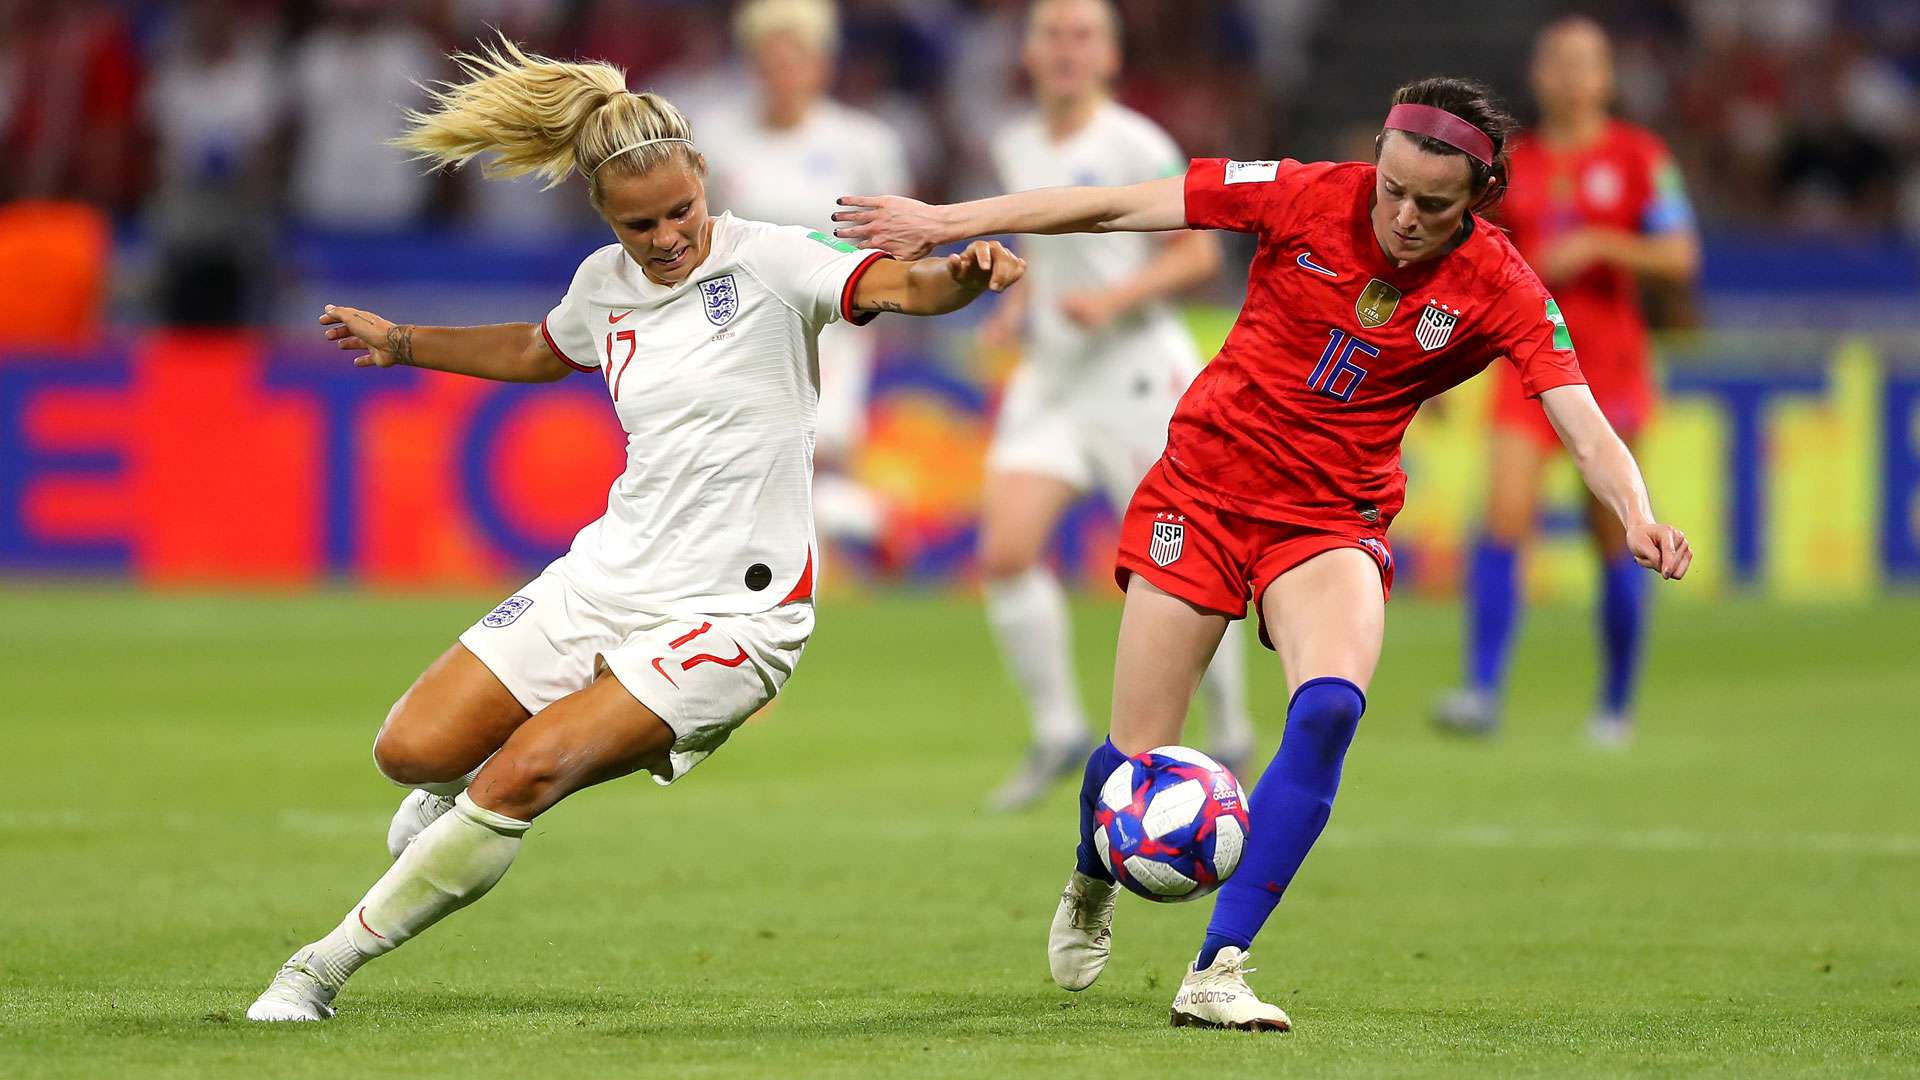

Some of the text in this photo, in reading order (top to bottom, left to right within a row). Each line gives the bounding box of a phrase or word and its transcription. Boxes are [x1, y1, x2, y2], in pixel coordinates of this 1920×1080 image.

[1363, 307, 1379, 320] FIFA
[1426, 307, 1455, 327] USA
[605, 329, 637, 402] 17
[1306, 329, 1380, 401] 16
[1156, 524, 1181, 542] USA
[669, 622, 749, 671] 17
[1191, 988, 1236, 1004] balance
